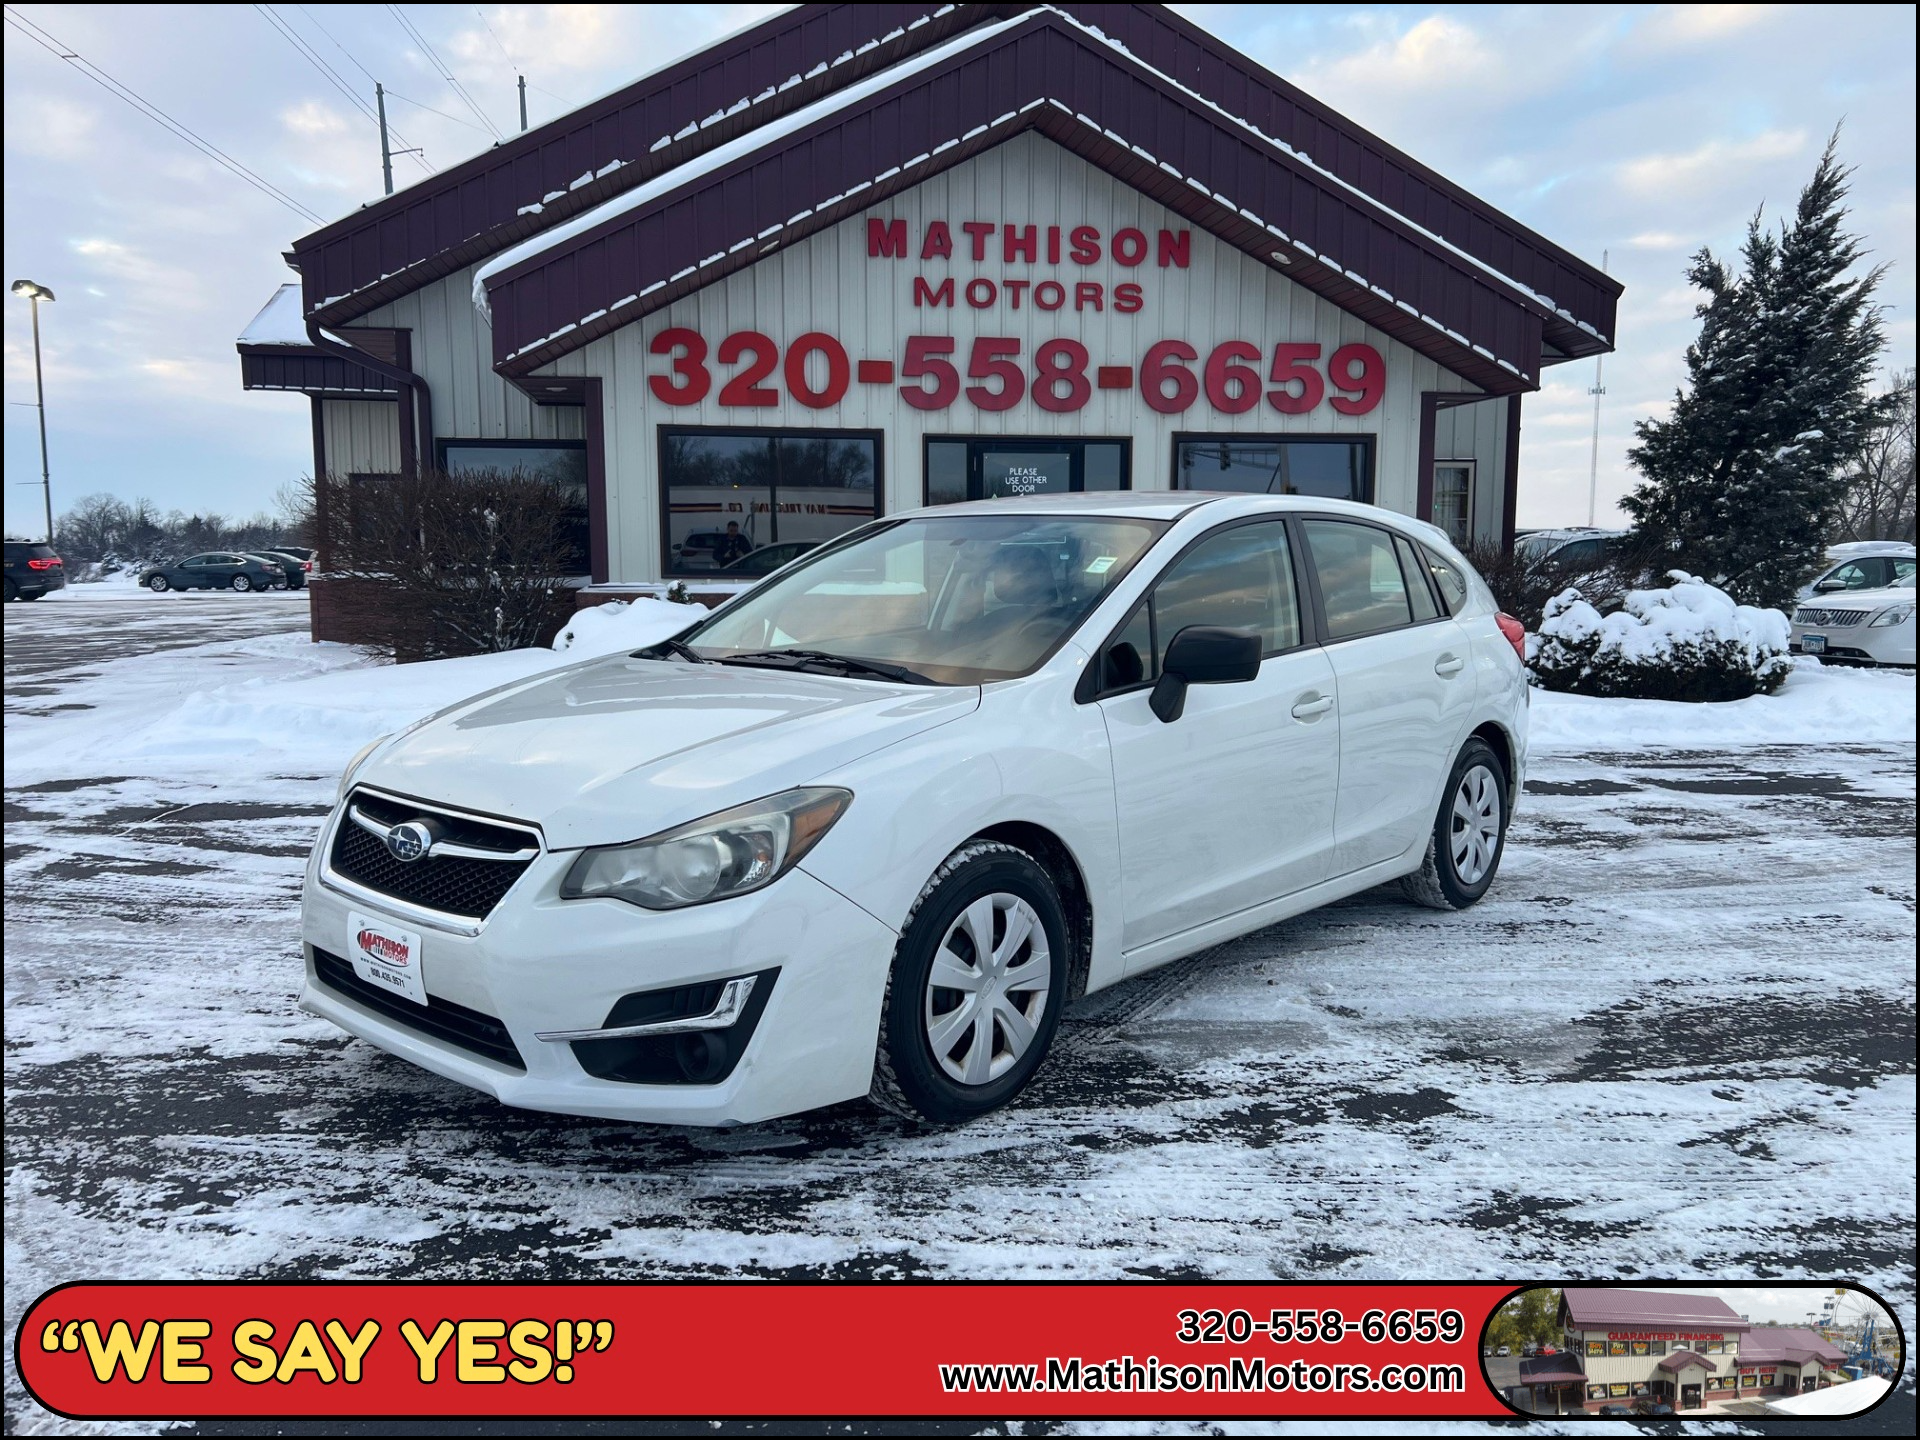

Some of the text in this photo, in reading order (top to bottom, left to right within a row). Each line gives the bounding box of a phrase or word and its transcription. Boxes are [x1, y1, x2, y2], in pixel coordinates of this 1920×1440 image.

[869, 218, 1190, 267] MATHISON
[914, 277, 1143, 313] MOTORS
[649, 327, 1386, 415] 320-558-6659
[1005, 476, 1048, 485] USE OTHER
[1009, 467, 1038, 476] PLEASE
[1012, 485, 1035, 493] DOOR
[360, 930, 409, 958] MATHISON
[384, 949, 407, 965] MOTORS
